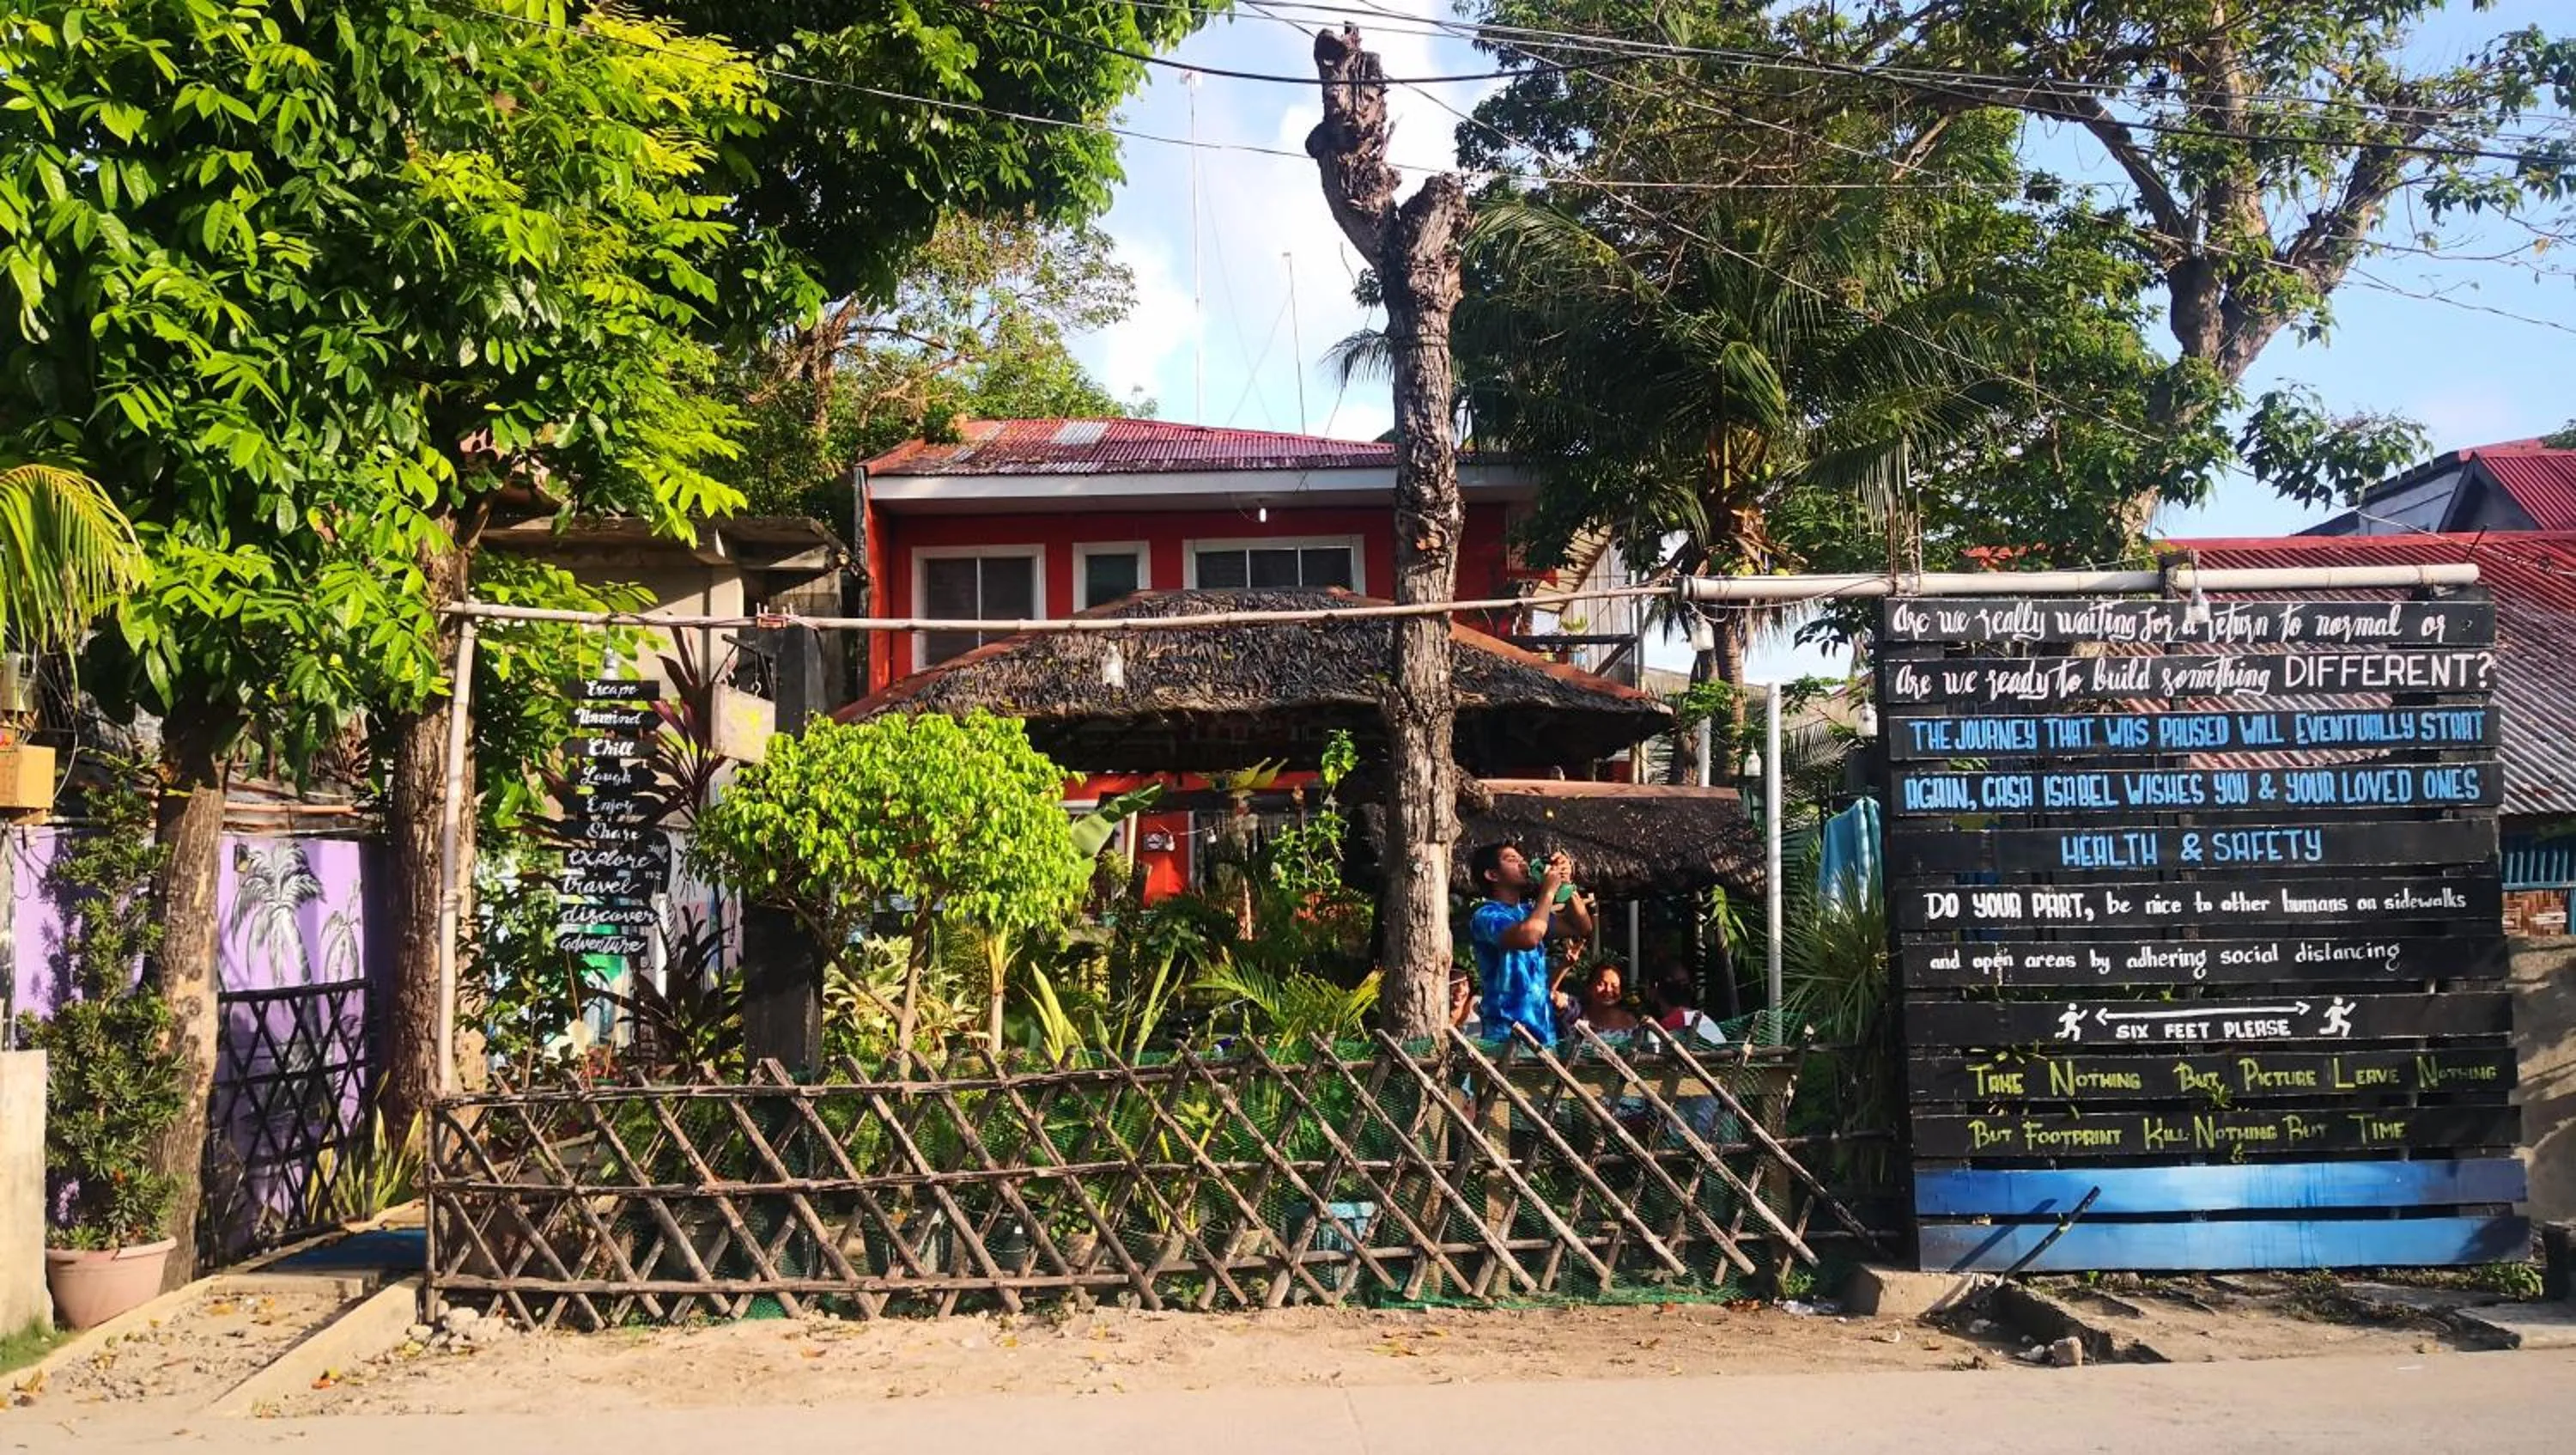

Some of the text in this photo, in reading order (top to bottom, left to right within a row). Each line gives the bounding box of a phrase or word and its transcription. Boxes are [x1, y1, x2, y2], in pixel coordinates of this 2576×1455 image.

[1893, 600, 2446, 643] Are we really waiting for a return to normal or
[1895, 652, 2493, 701] Are we ready to build something DIFFERENT?
[1910, 711, 2486, 751] THE JOURNEY THAT WAS PAUSED WILL EVENTUALLY START
[588, 737, 635, 757] Chill
[580, 766, 633, 786] Laugh
[1904, 769, 2481, 811] AGAIN, CASA ISABEL WISHES YOU & YOUR LOVED ONES
[586, 794, 634, 814] Enjoy
[586, 822, 641, 840] Share
[2062, 829, 2323, 866] HEALTH & SAFETY
[559, 874, 641, 895] travel
[559, 904, 660, 923] discover
[1923, 887, 2467, 922] DO YOUR PART, be nice to other humans on sidewalks
[1930, 942, 2401, 980] and open areas by adhering social distancing
[2116, 1020, 2291, 1039] SIX FEET PLEASE
